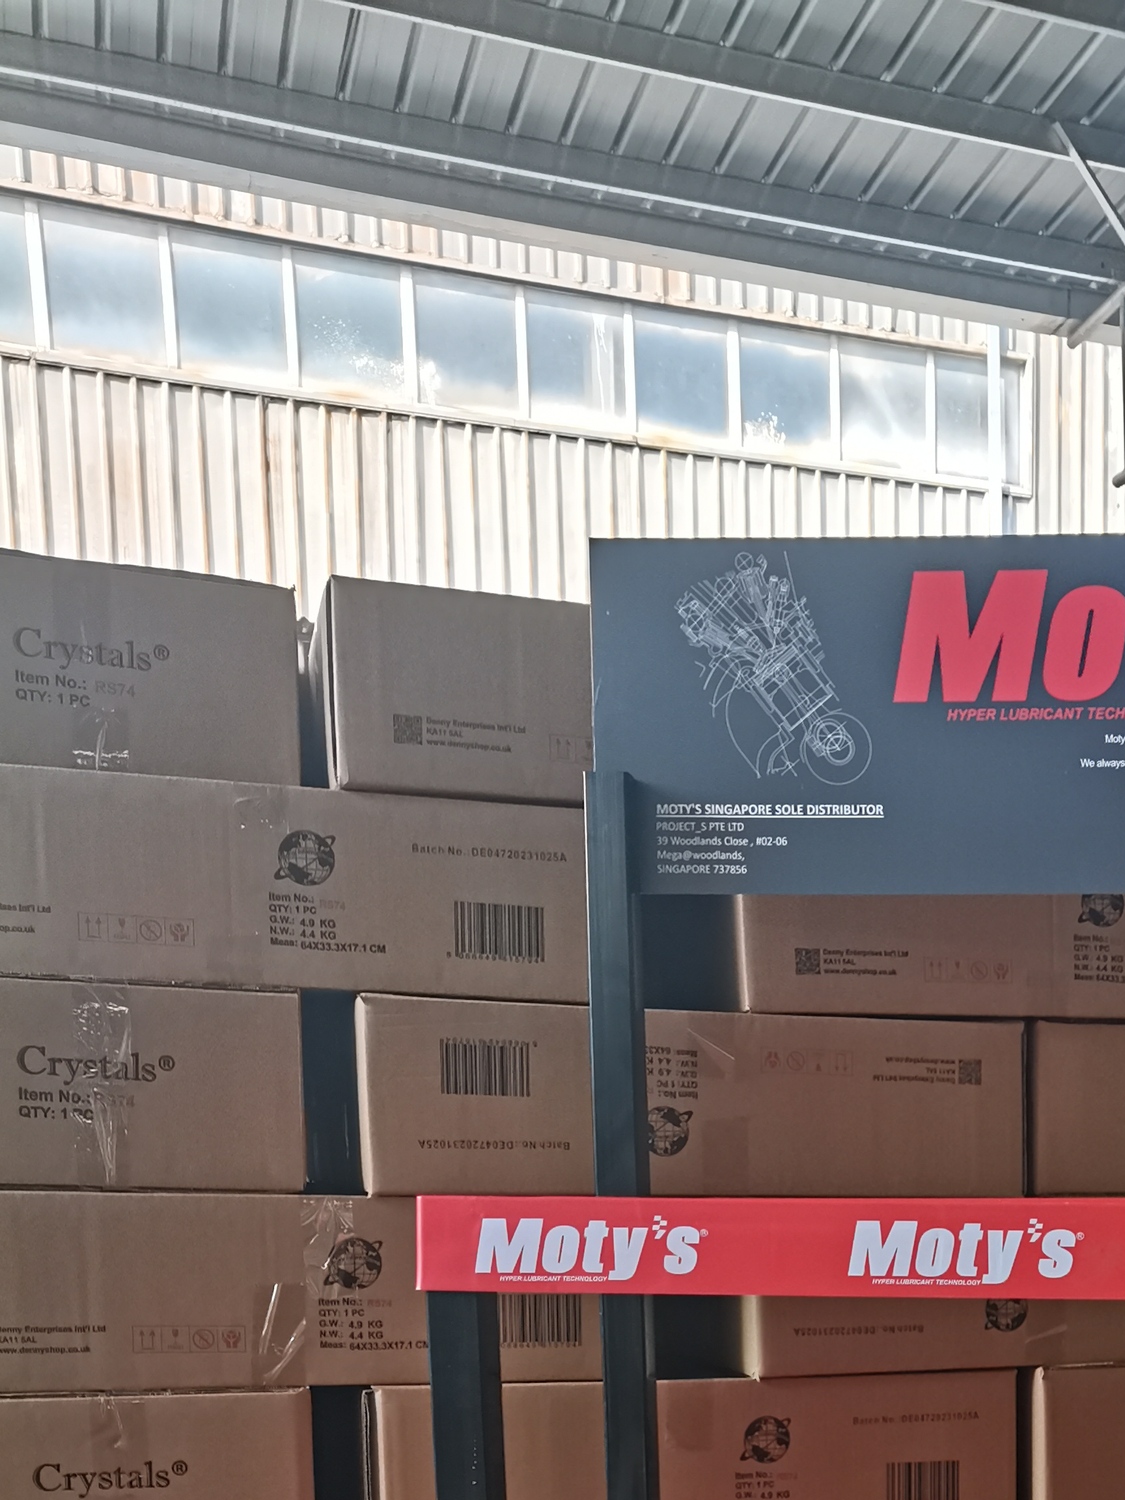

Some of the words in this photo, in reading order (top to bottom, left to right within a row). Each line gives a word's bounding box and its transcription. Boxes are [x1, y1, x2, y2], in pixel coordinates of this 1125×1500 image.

[15, 669, 49, 686] Item
[55, 674, 87, 690] No.:
[15, 688, 52, 703] QTY:
[58, 693, 64, 704] 1
[70, 694, 90, 707] PC
[946, 707, 996, 721] HYPER
[998, 706, 1084, 721] LUBRICANT
[1079, 757, 1095, 768] We
[1095, 758, 1125, 769] always
[656, 803, 702, 815] MOTY'S
[704, 803, 773, 815] SINGAPORE
[775, 803, 804, 815] SOLE
[806, 803, 884, 815] DISTRIBUTOR
[708, 821, 725, 831] PTE
[727, 821, 744, 831] LTD
[656, 835, 668, 845] 39
[669, 835, 722, 846] Woodlands
[755, 836, 788, 846] #02-06
[656, 849, 745, 861] Mega@woodlands,
[656, 863, 710, 874] SINGAPORE
[712, 864, 747, 874] 737856
